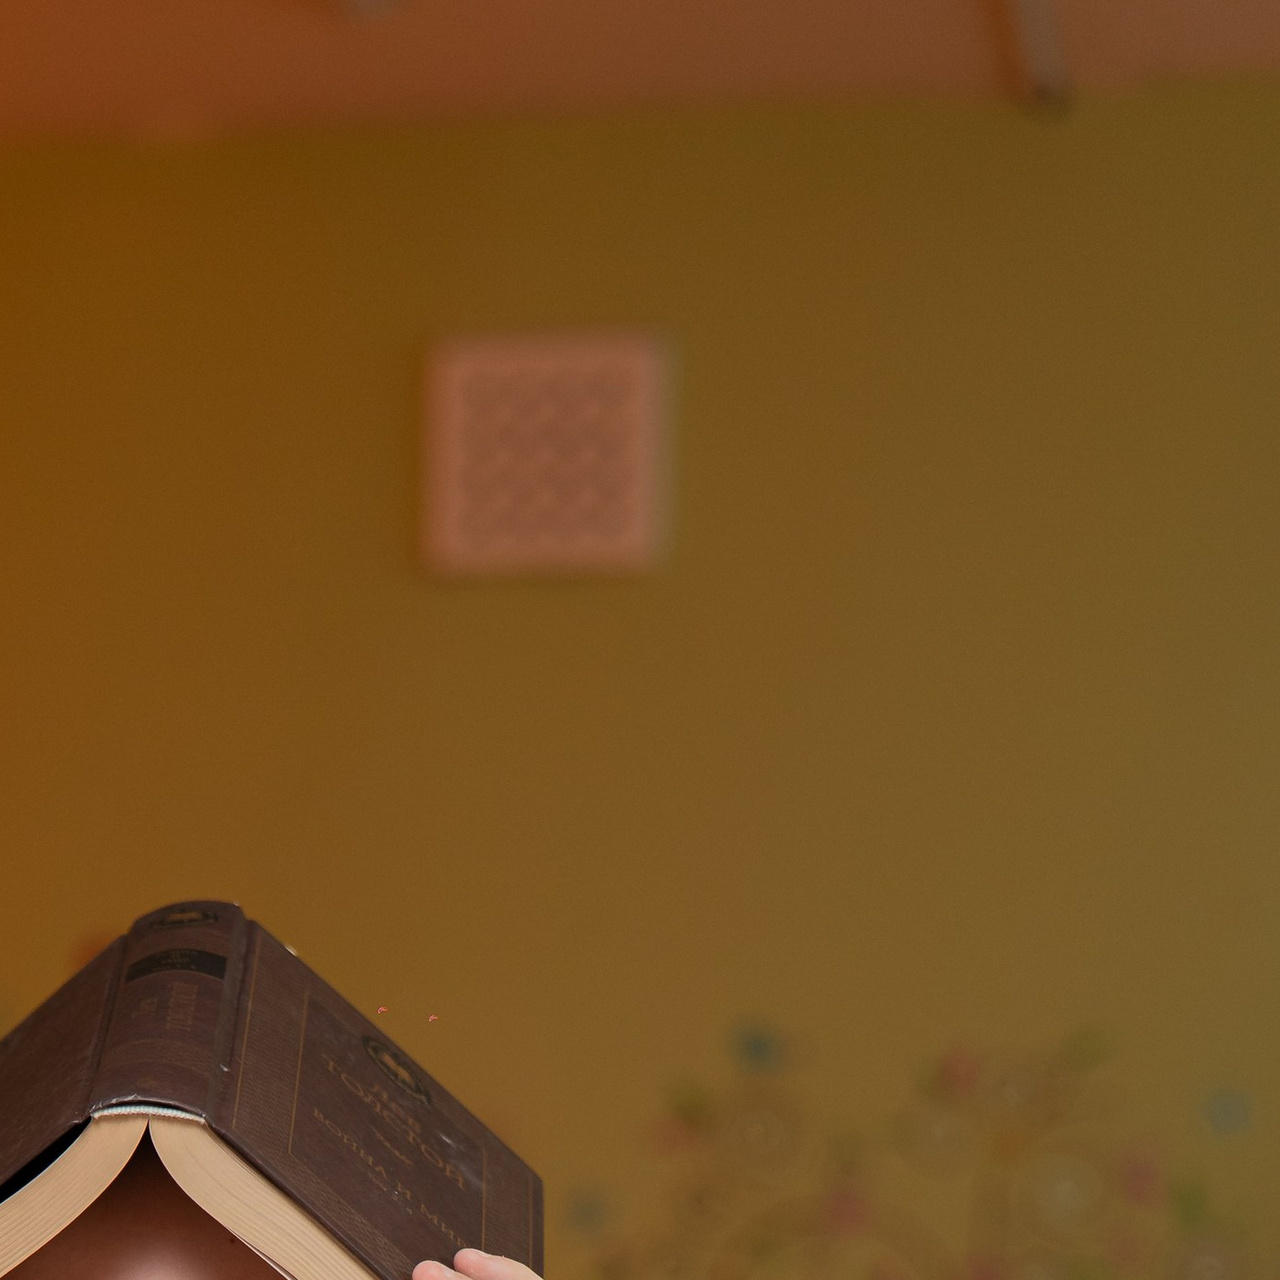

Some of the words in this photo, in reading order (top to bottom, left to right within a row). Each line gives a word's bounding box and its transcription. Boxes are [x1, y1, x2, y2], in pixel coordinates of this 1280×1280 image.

[313, 1108, 390, 1181] ВОЙНА
[396, 1177, 415, 1203] И
[322, 1053, 468, 1194] ТОЛСТОЙ
